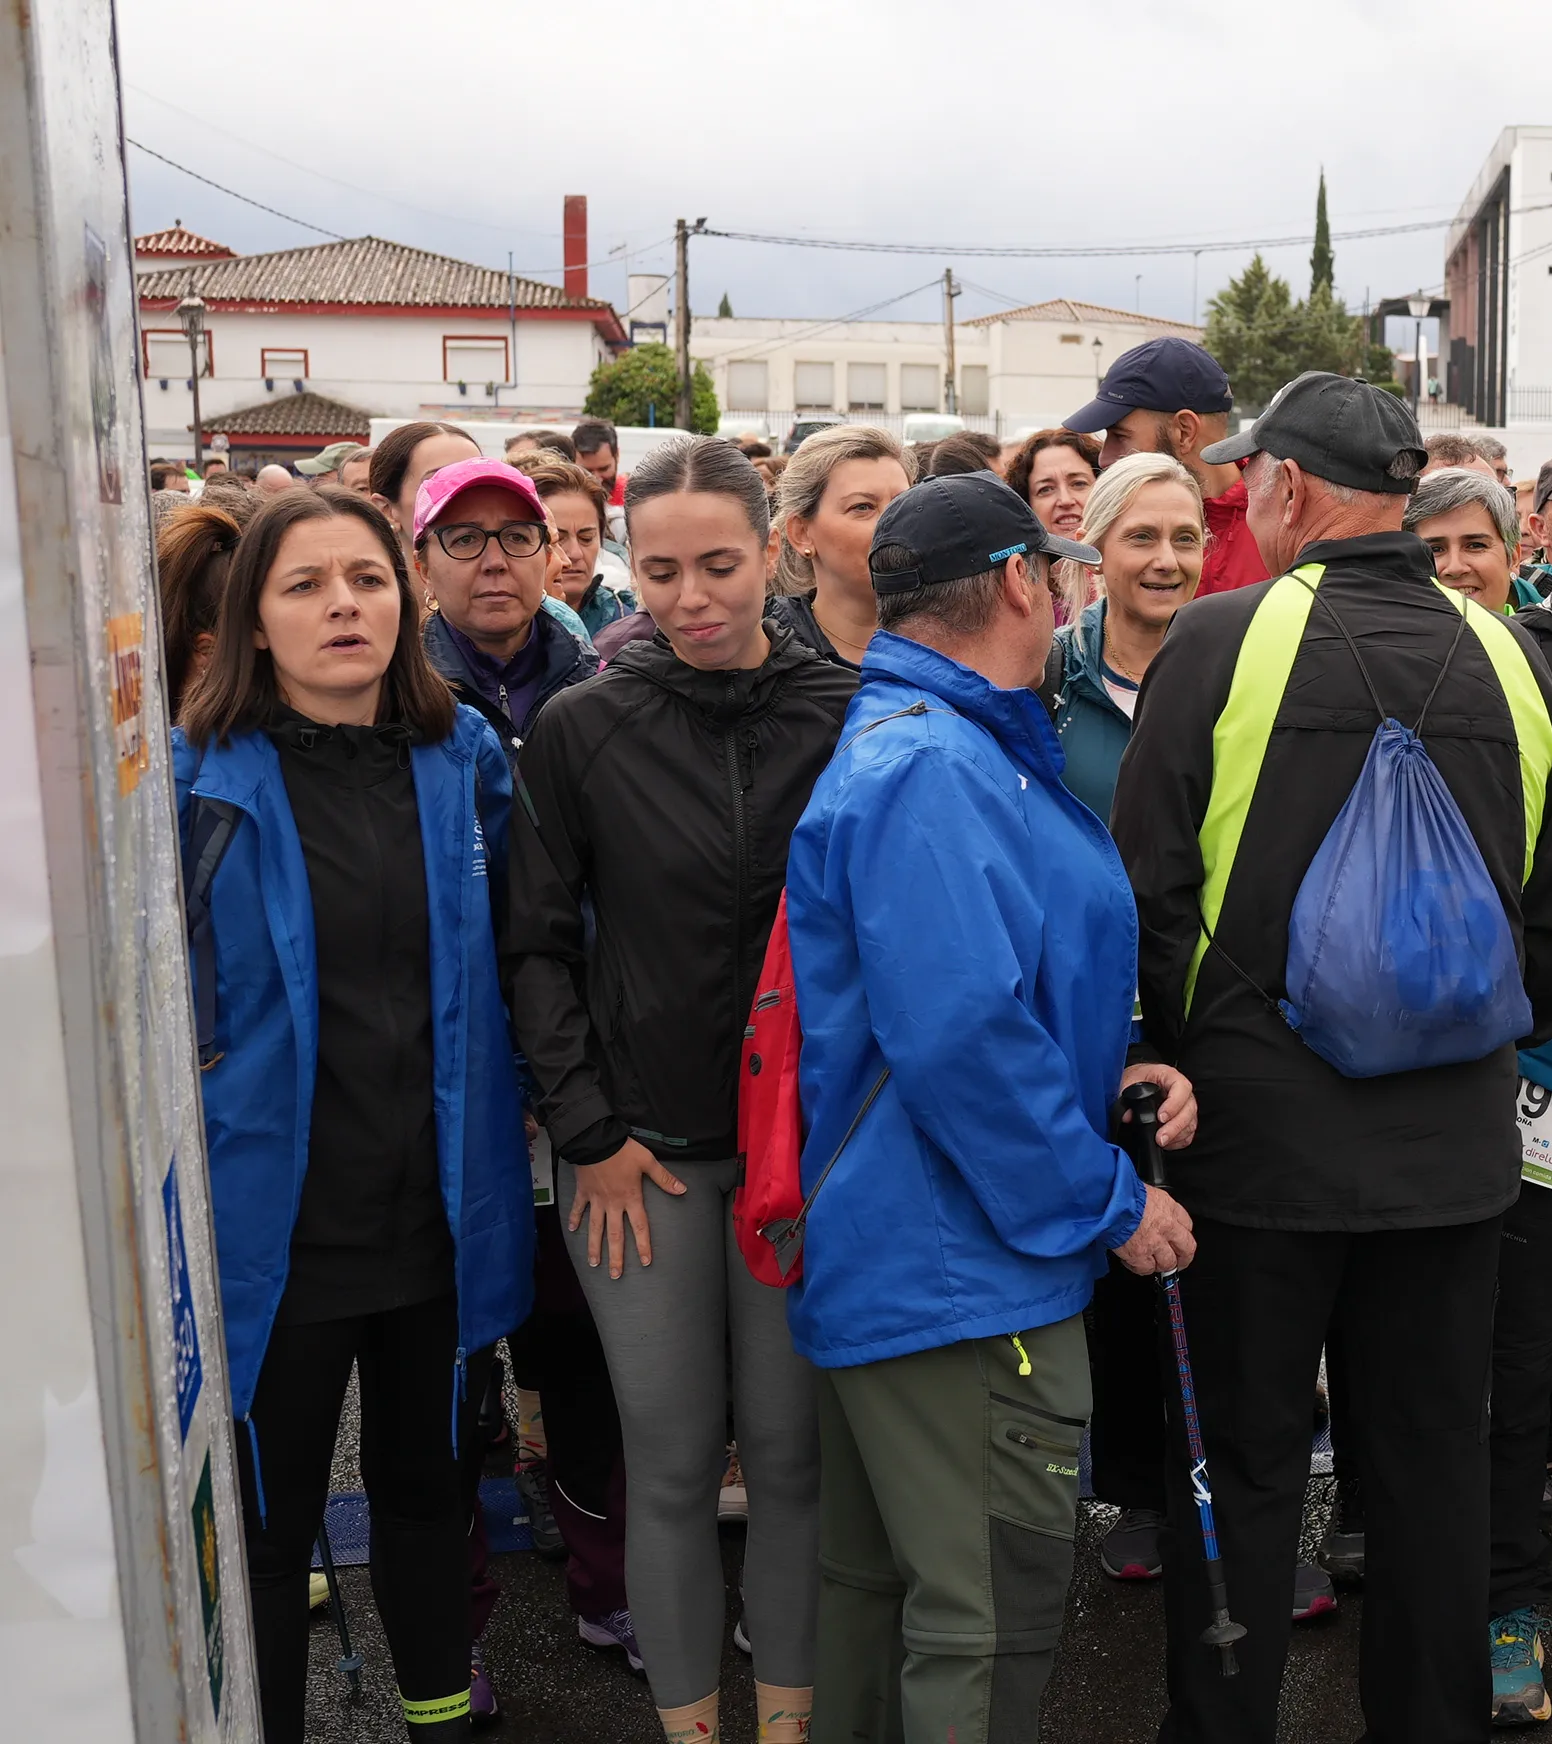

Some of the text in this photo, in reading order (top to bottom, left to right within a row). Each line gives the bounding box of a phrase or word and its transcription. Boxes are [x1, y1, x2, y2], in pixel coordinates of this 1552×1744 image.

[990, 544, 1027, 560] MONTORO
[1500, 1231, 1528, 1244] UECHUA
[1168, 1282, 1204, 1458] TREKKING
